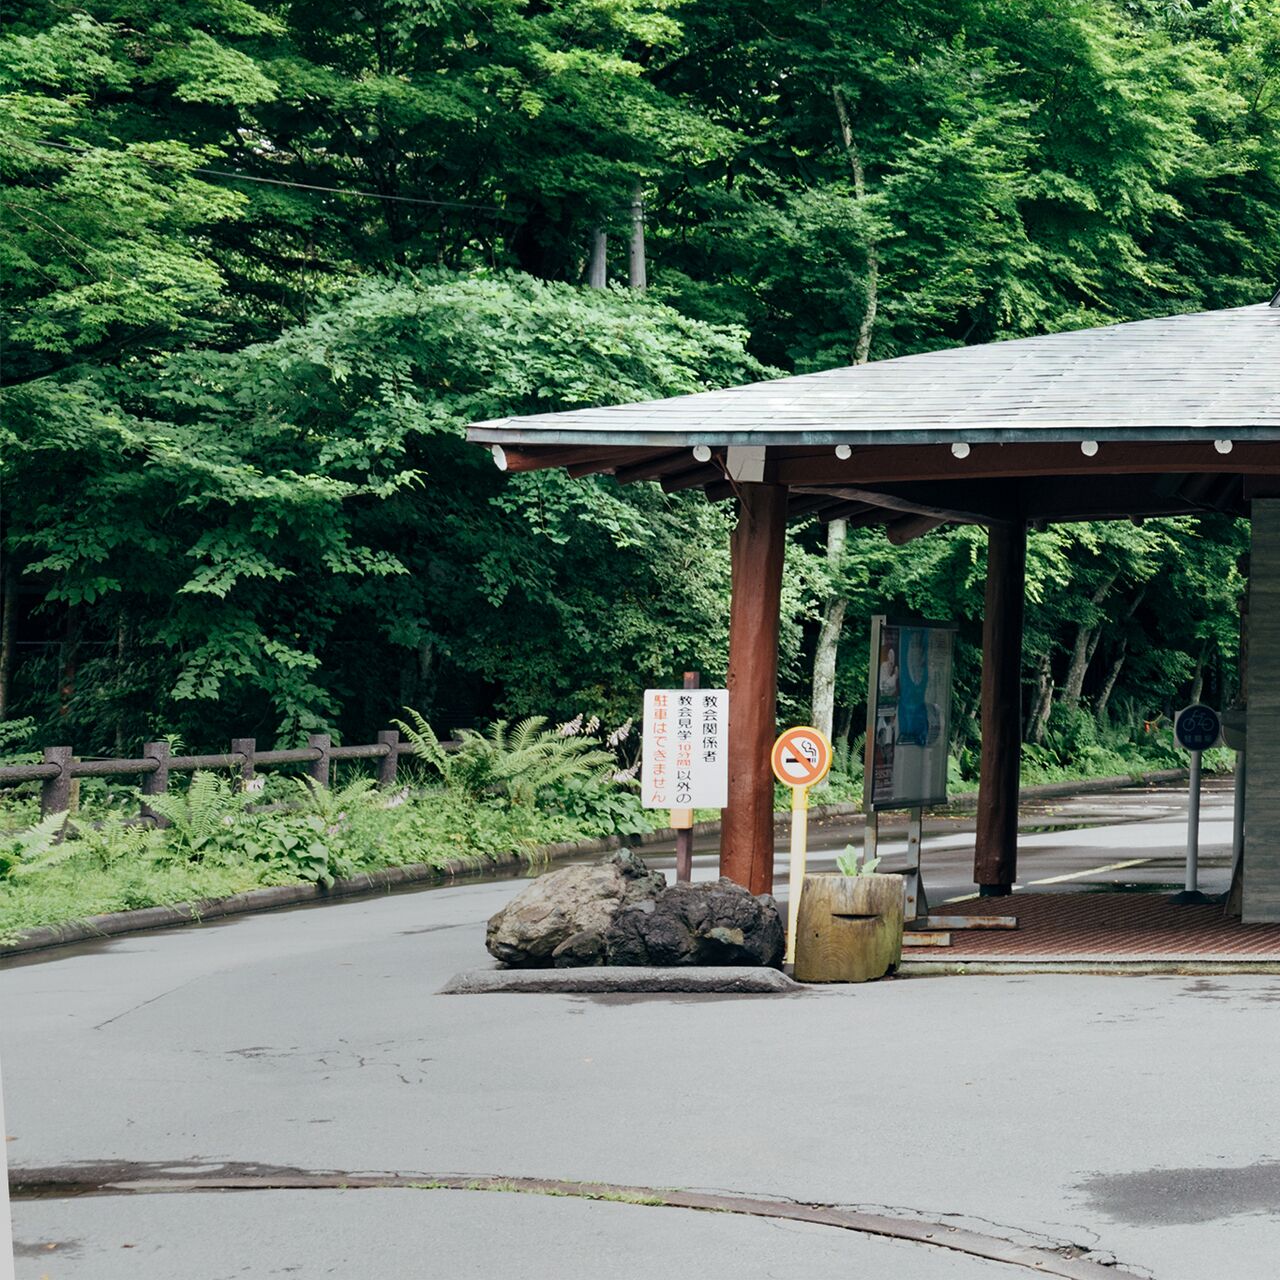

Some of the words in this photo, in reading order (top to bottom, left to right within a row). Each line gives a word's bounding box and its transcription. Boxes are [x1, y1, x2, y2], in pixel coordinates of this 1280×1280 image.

[651, 694, 668, 803] 駐車はできません
[702, 695, 718, 763] 教会関係者
